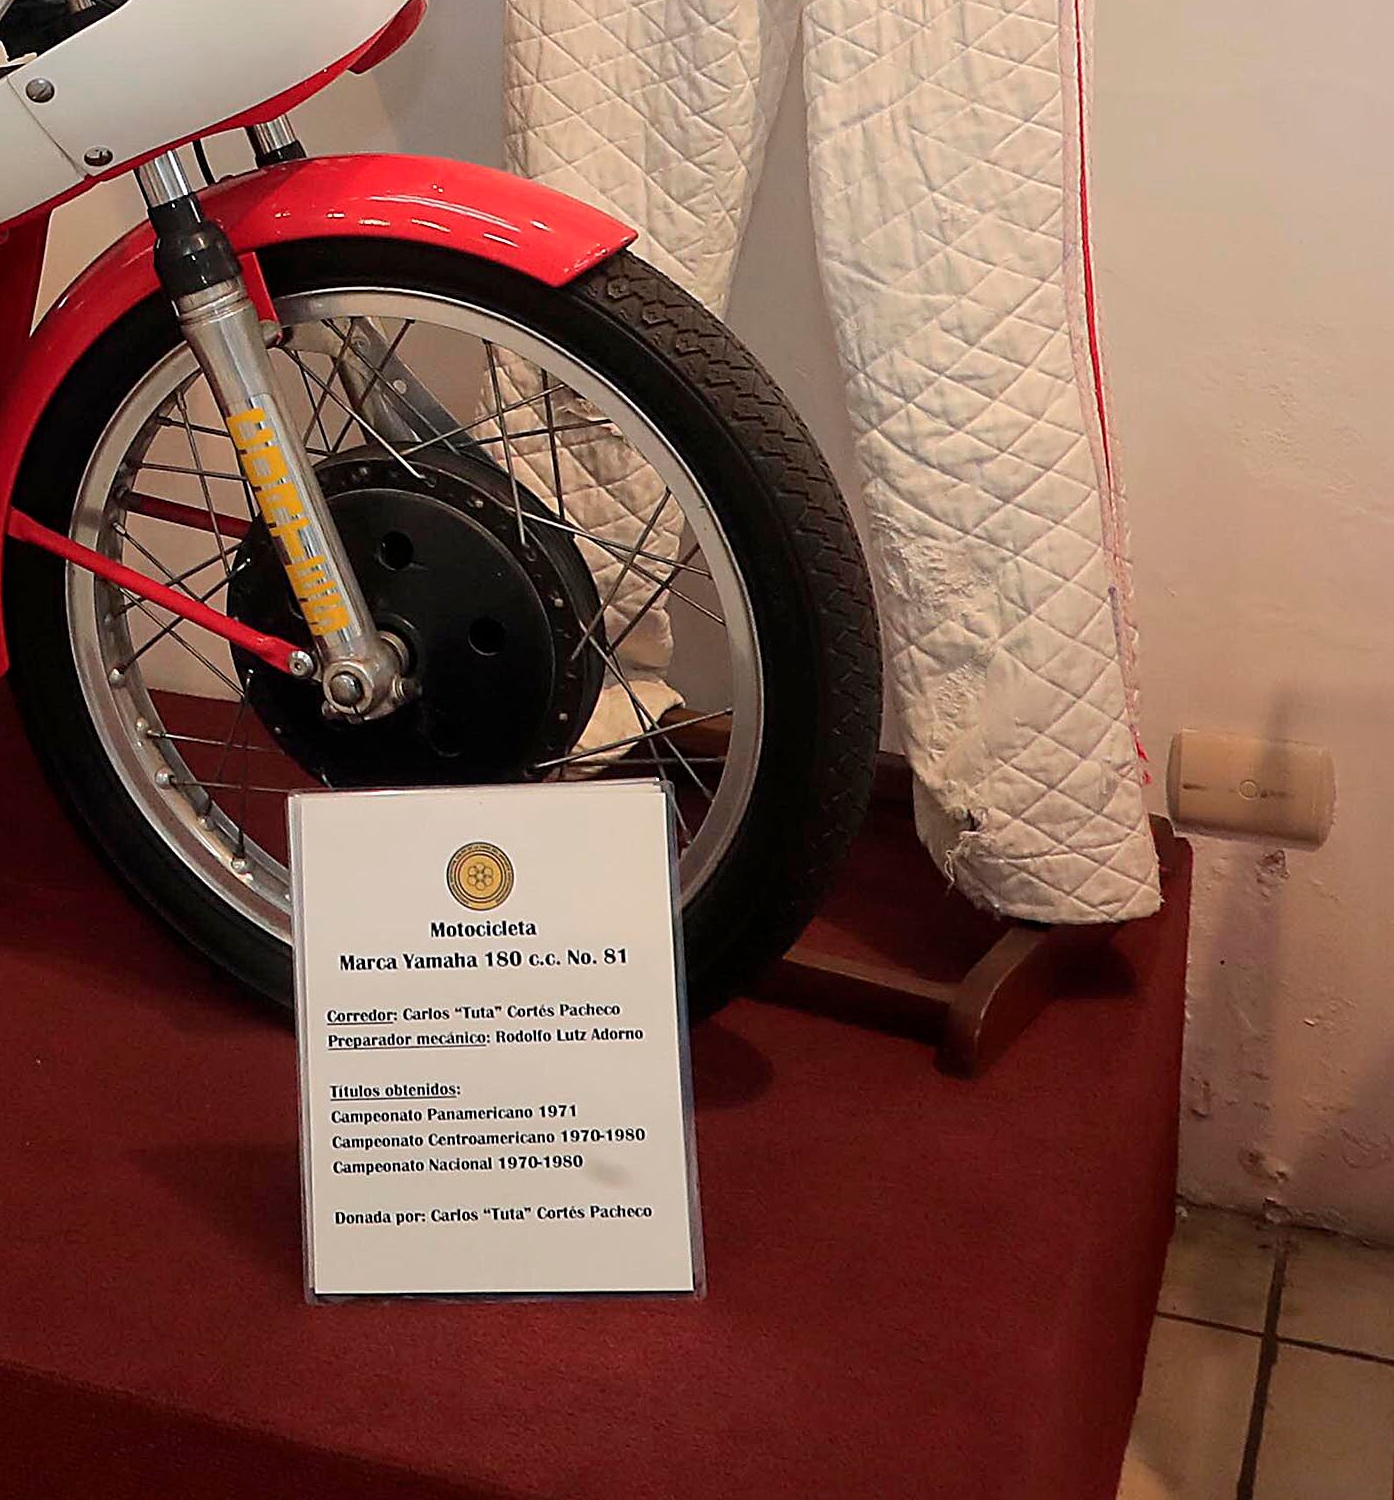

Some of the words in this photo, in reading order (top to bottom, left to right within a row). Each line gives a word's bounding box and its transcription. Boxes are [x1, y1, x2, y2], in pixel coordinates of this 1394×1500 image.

[227, 407, 350, 636] CORTES
[431, 920, 536, 937] Motocicleta
[340, 955, 397, 970] Marca
[403, 952, 478, 969] Yamaha
[485, 951, 522, 967] 180
[529, 954, 561, 966] c.c.
[568, 950, 597, 965] No.
[604, 948, 626, 964] 81
[326, 1009, 398, 1023] Corredor:
[402, 1007, 450, 1021] Carlos
[507, 1005, 555, 1018] Cortés
[560, 1003, 620, 1016] Pacheco
[328, 1033, 412, 1049] Preparador
[417, 1031, 490, 1045] mecánico:
[496, 1030, 552, 1043] Rodolfo
[556, 1029, 587, 1042] Lutz
[591, 1028, 644, 1041] Adorno
[385, 1082, 461, 1097] obtenidos:
[331, 1110, 422, 1125] Campeonato
[428, 1106, 533, 1121] Panamericano
[539, 1105, 576, 1118] 1971
[332, 1135, 423, 1150] Campeonato
[428, 1131, 555, 1146] Centroamericano
[561, 1128, 645, 1142] 1970-1980
[333, 1160, 424, 1175] Campeonato
[429, 1157, 492, 1171] Nacional
[499, 1155, 583, 1169] 1970-1980
[335, 1211, 391, 1224] Donada
[396, 1213, 425, 1226] por:
[431, 1209, 478, 1222] Carlos
[537, 1206, 585, 1219] Cortés
[590, 1205, 652, 1218] Pacheco
